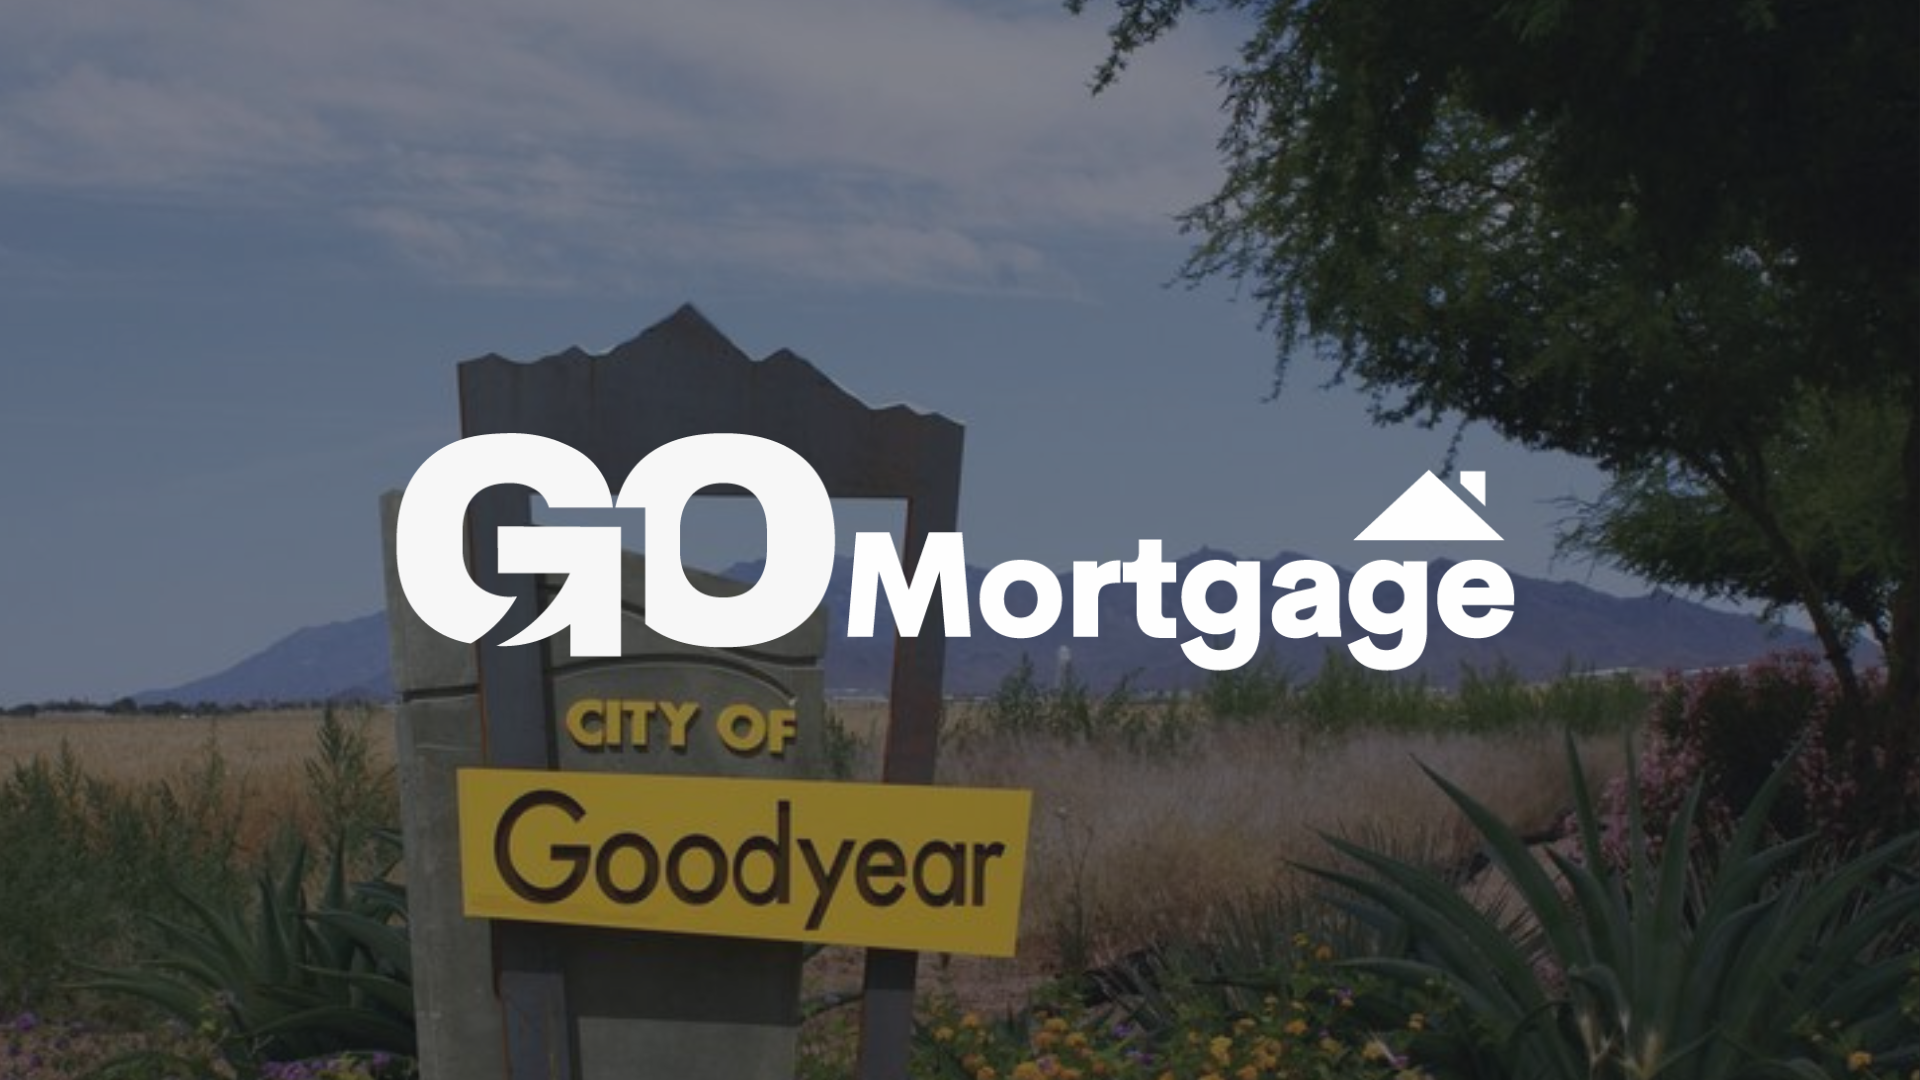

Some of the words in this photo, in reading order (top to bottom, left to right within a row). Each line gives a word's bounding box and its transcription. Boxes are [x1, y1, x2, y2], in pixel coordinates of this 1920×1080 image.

[565, 698, 700, 750] CITY
[716, 703, 797, 756] OF
[494, 789, 1006, 931] Goodyear
